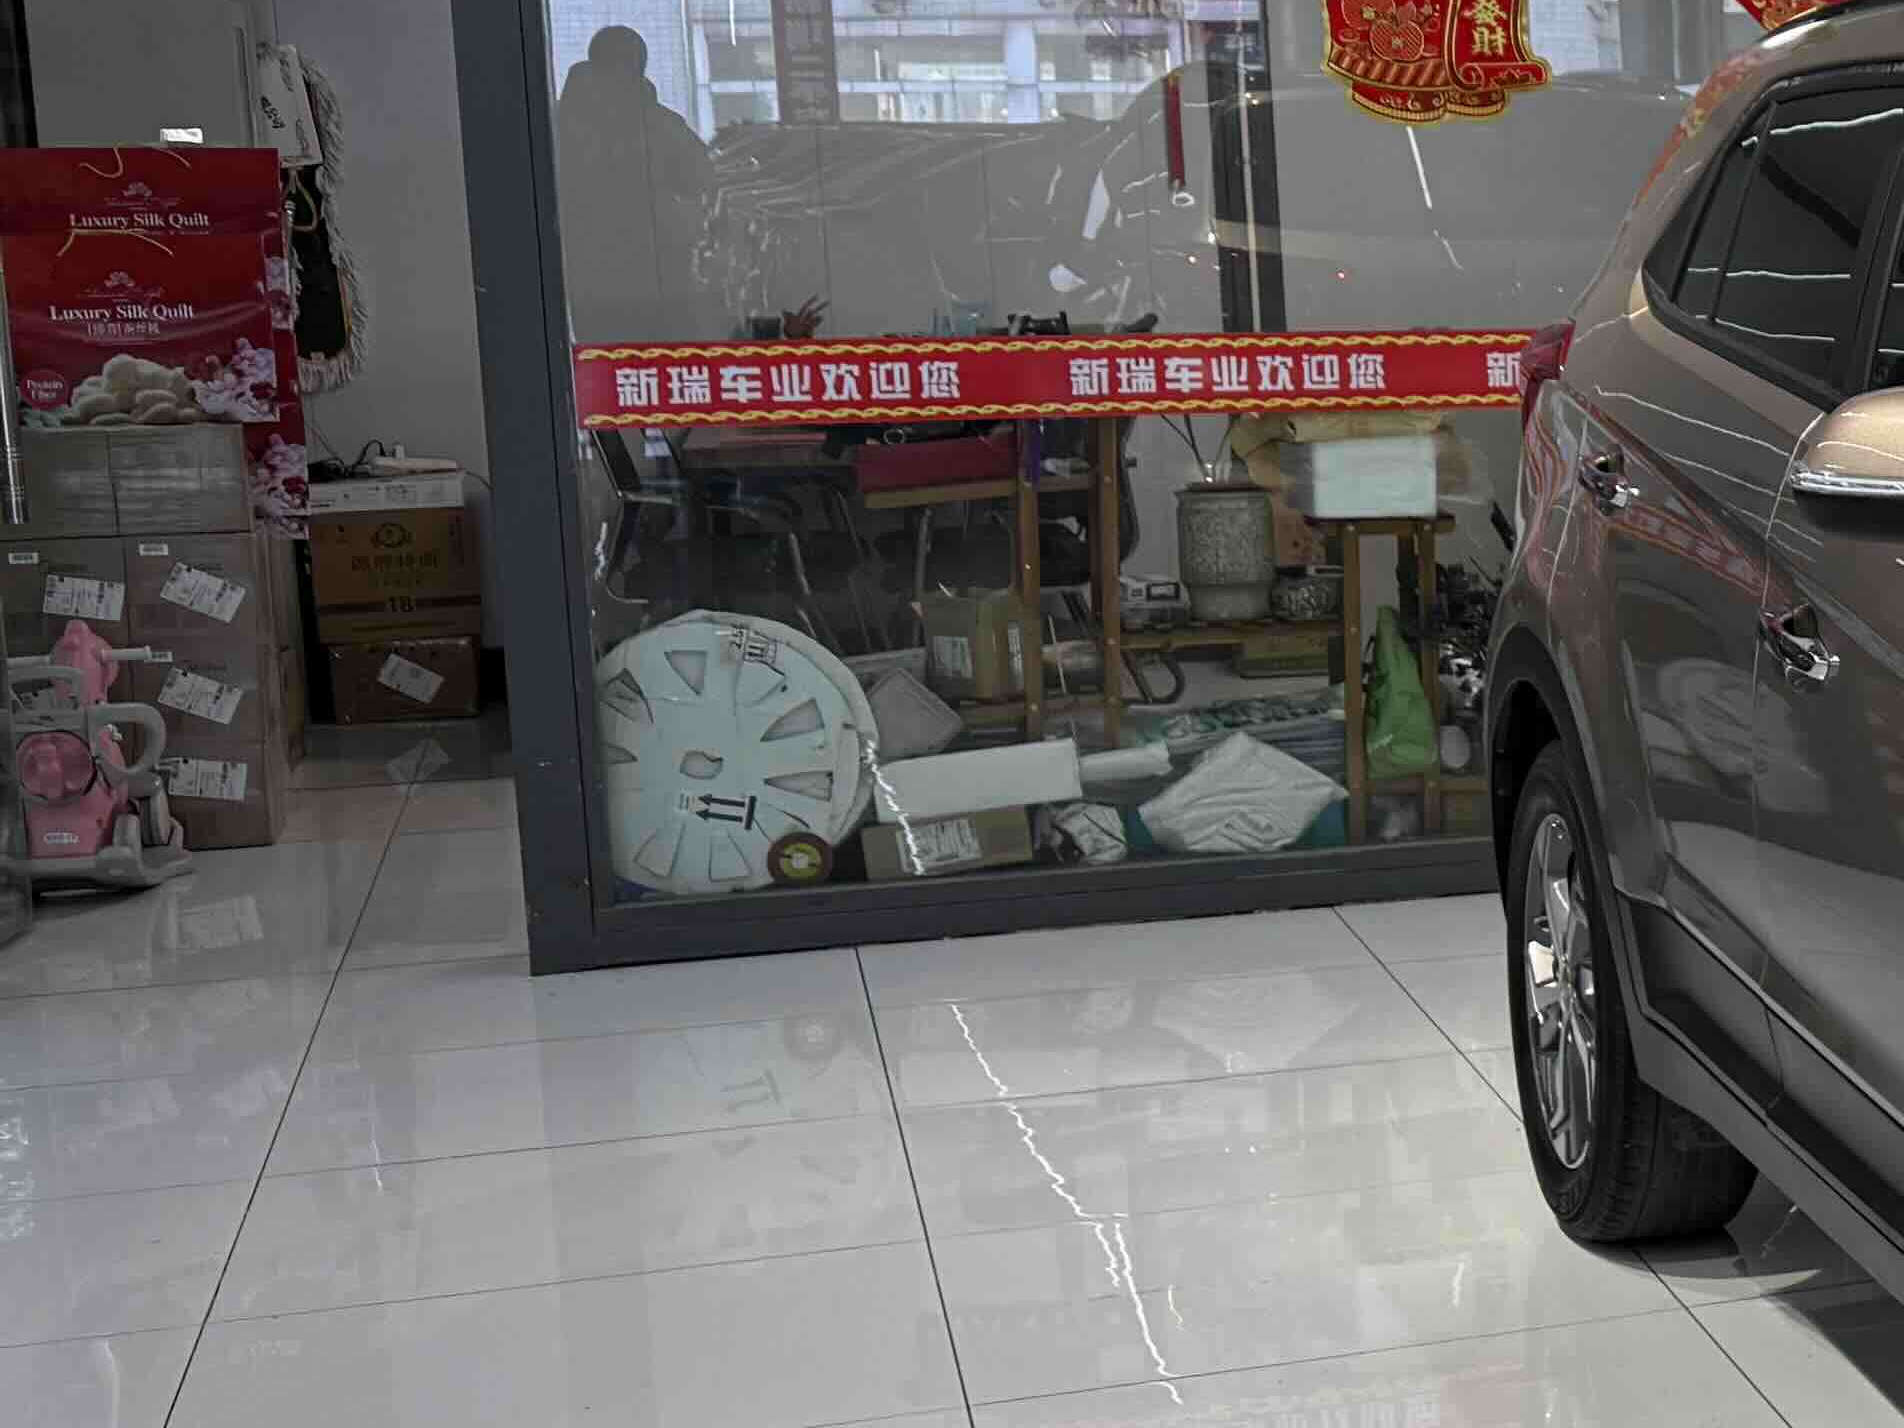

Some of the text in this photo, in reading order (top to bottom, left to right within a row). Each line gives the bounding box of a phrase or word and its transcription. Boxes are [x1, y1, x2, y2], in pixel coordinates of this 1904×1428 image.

[70, 212, 209, 230] Luxury Silk Quilt
[49, 304, 193, 322] Luxury Silk Quilt
[615, 359, 961, 407] 新瑞车业欢迎您
[1069, 350, 1387, 397] 新瑞车业欢迎您
